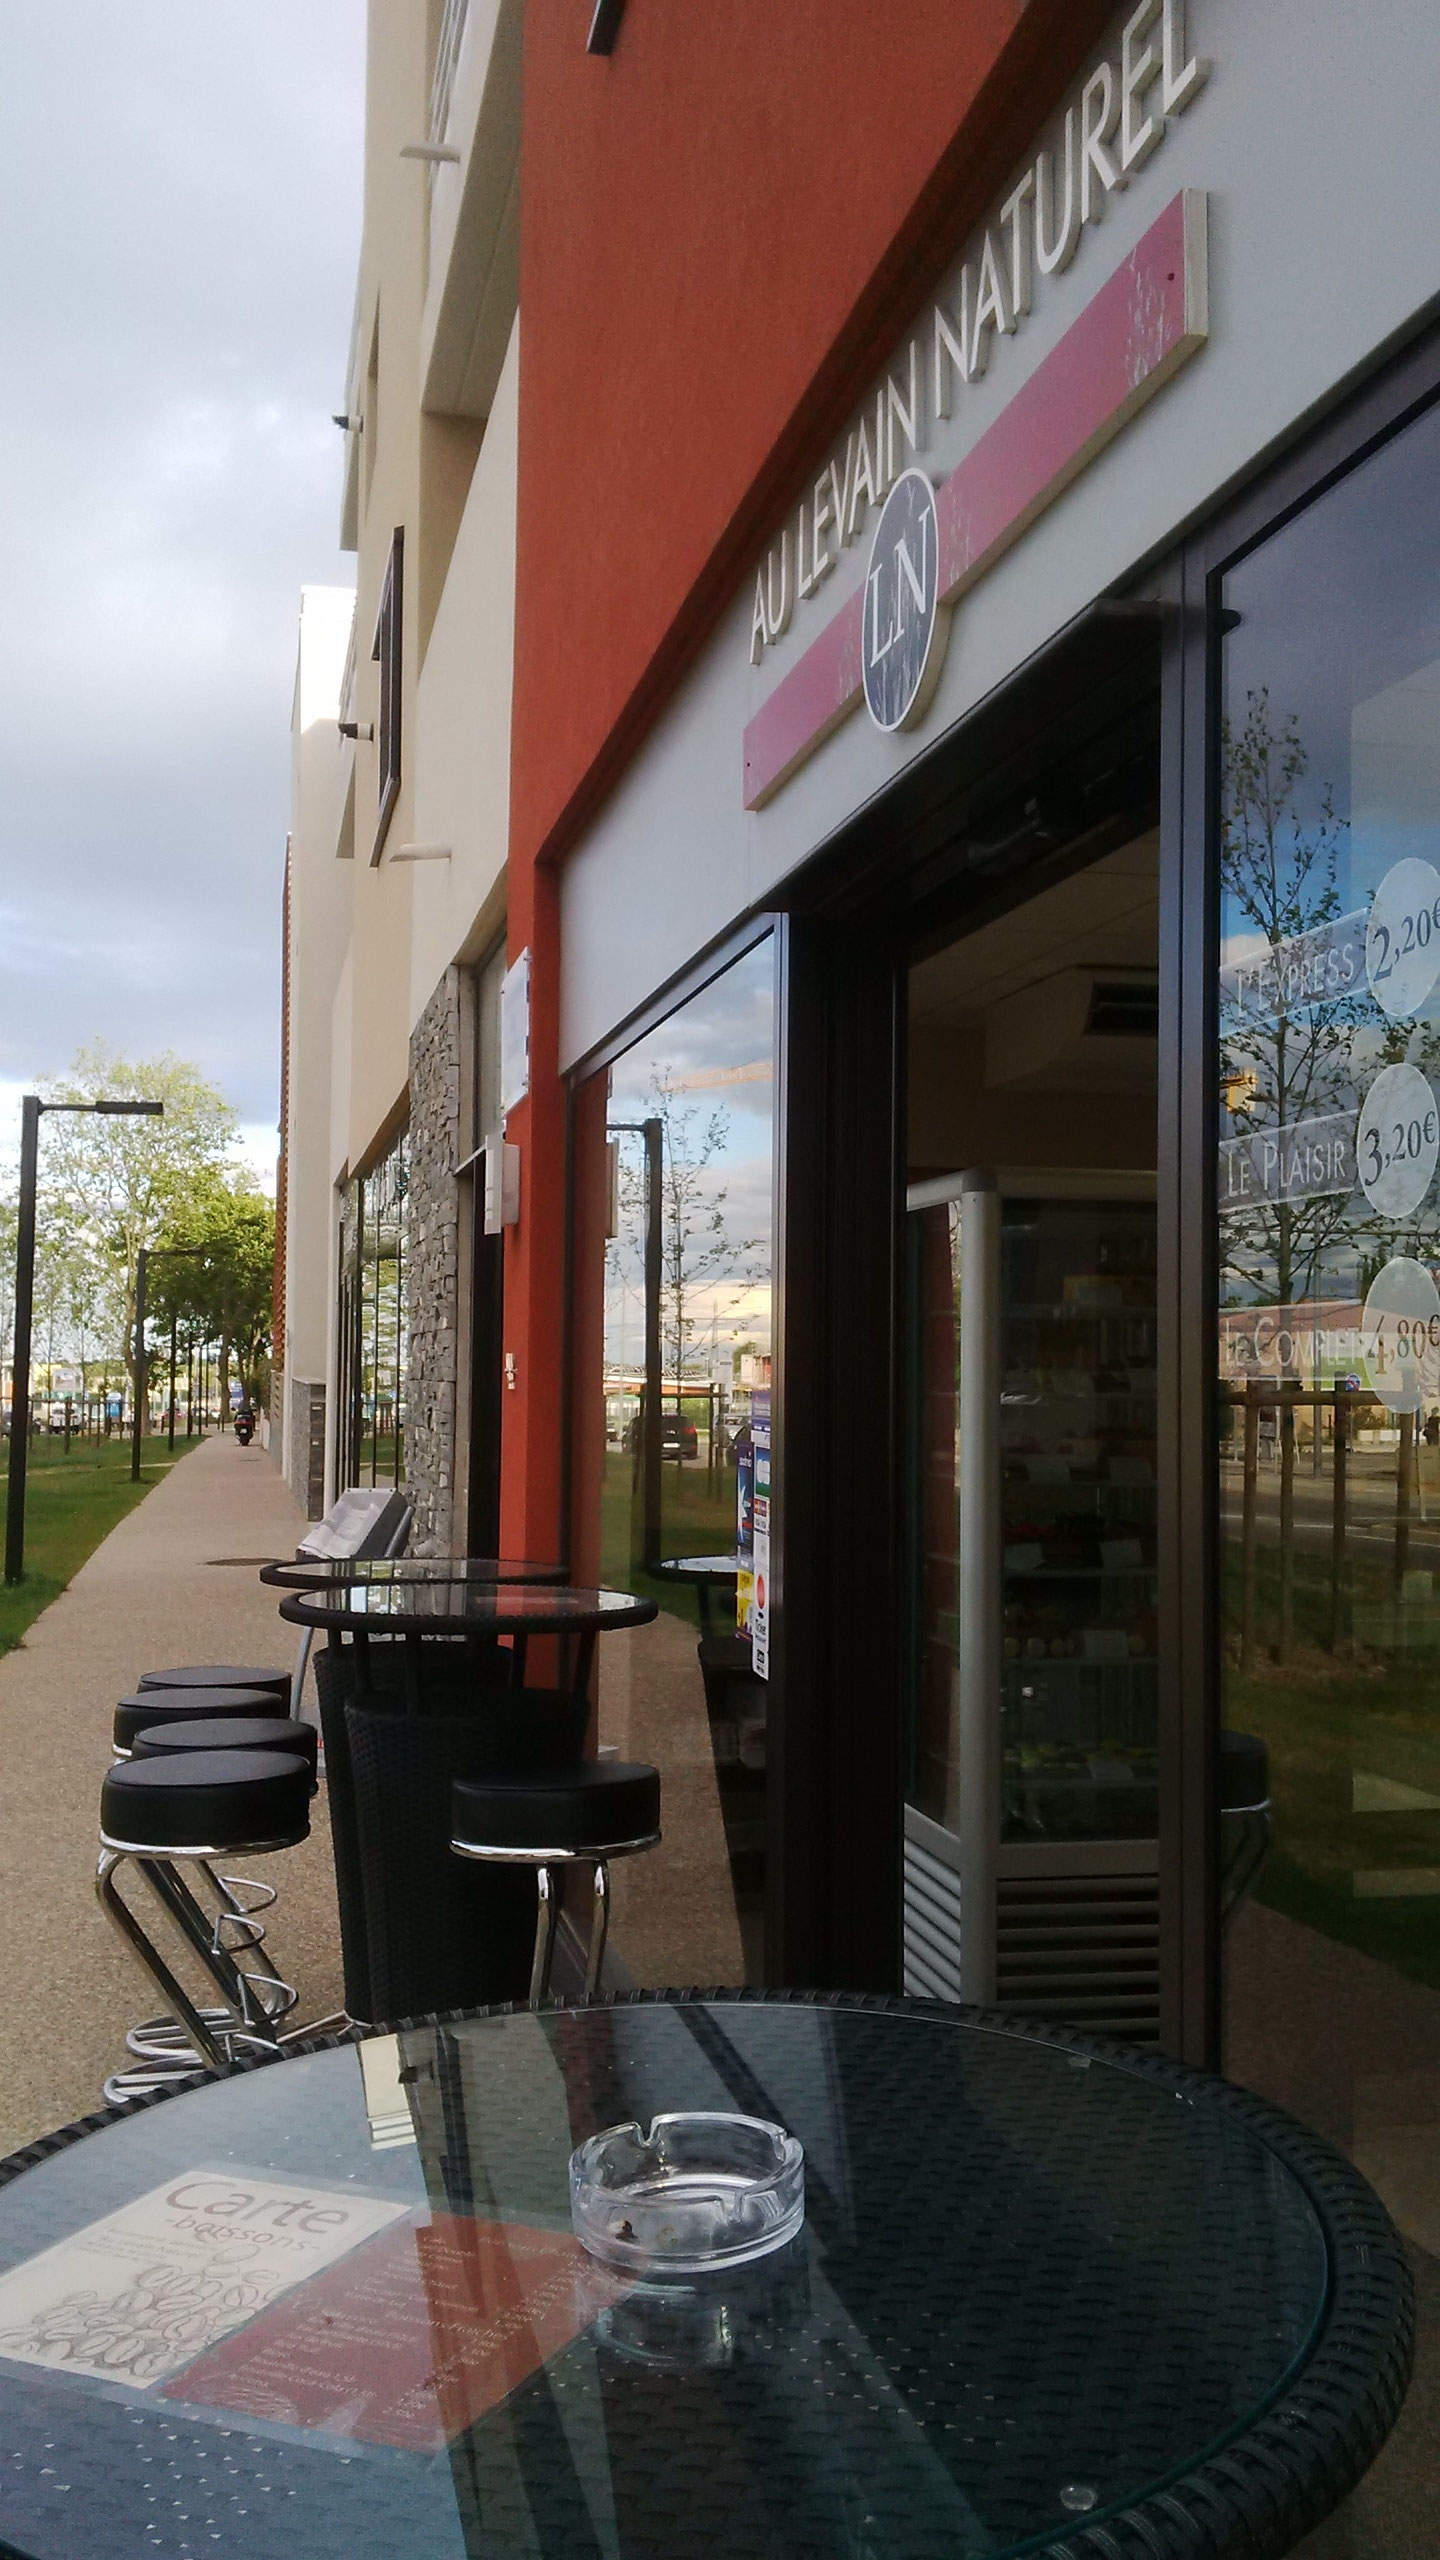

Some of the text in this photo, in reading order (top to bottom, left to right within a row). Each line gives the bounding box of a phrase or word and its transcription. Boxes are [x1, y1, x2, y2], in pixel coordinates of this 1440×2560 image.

[749, 0, 1202, 665] AU LEVAIN NATUREL
[869, 503, 931, 669] LN
[1228, 1111, 1437, 1198] LE PLAISIR 3,20€
[165, 2180, 350, 2234] Carte
